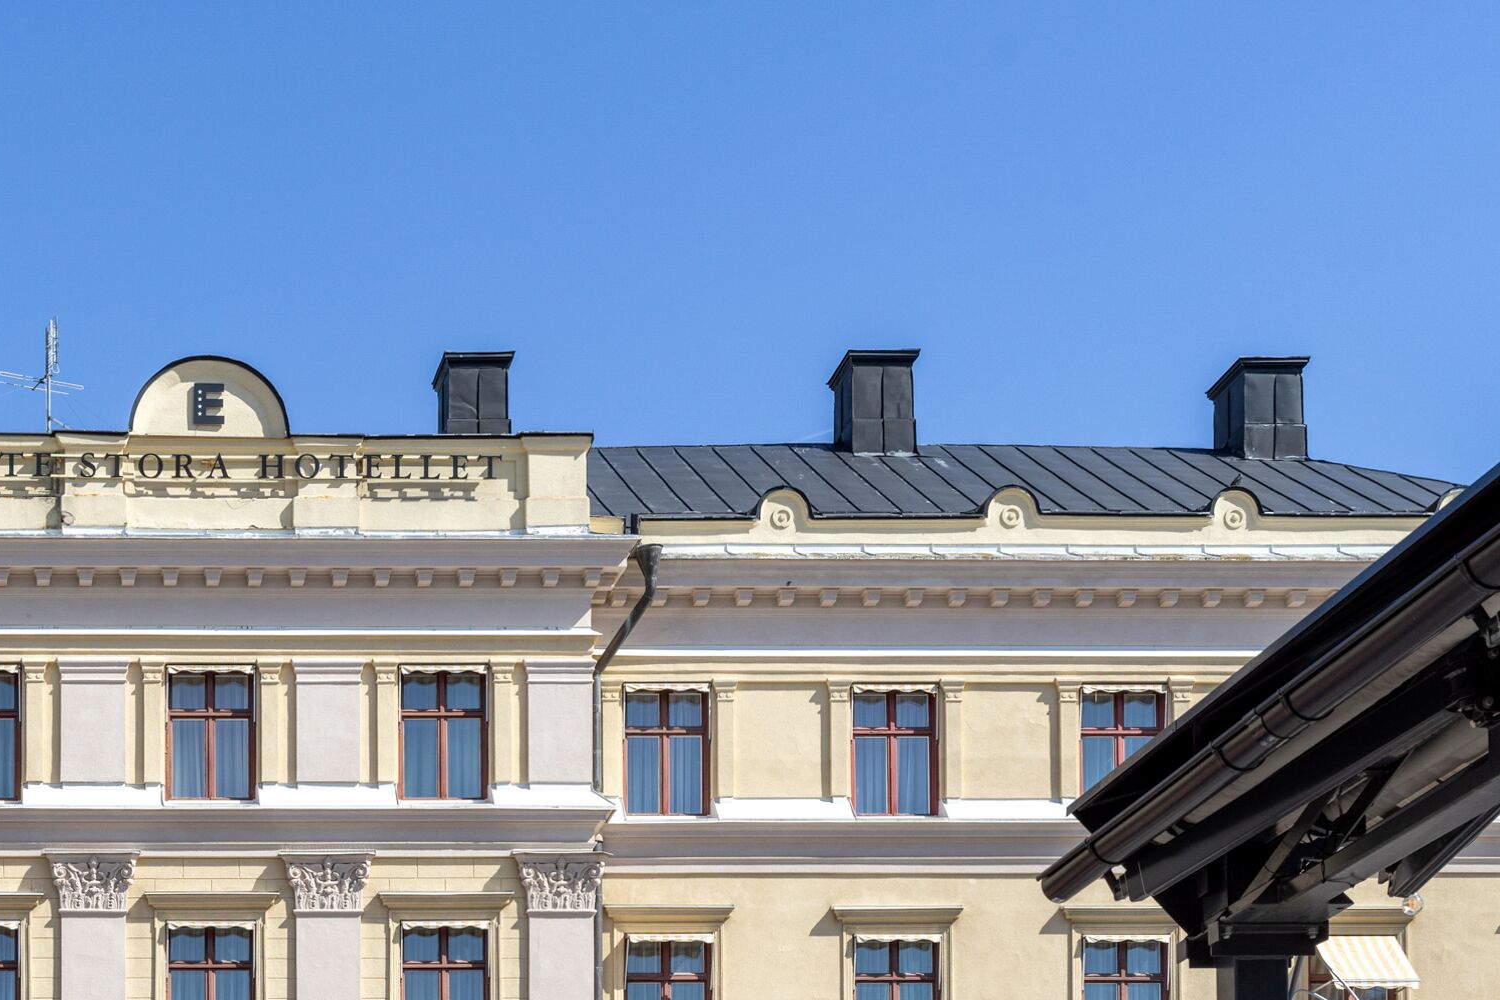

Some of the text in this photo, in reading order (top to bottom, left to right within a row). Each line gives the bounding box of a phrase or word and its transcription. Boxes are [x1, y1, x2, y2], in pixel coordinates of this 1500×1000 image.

[193, 383, 225, 425] E
[79, 452, 231, 479] STORA
[258, 452, 503, 479] HOTELLET
